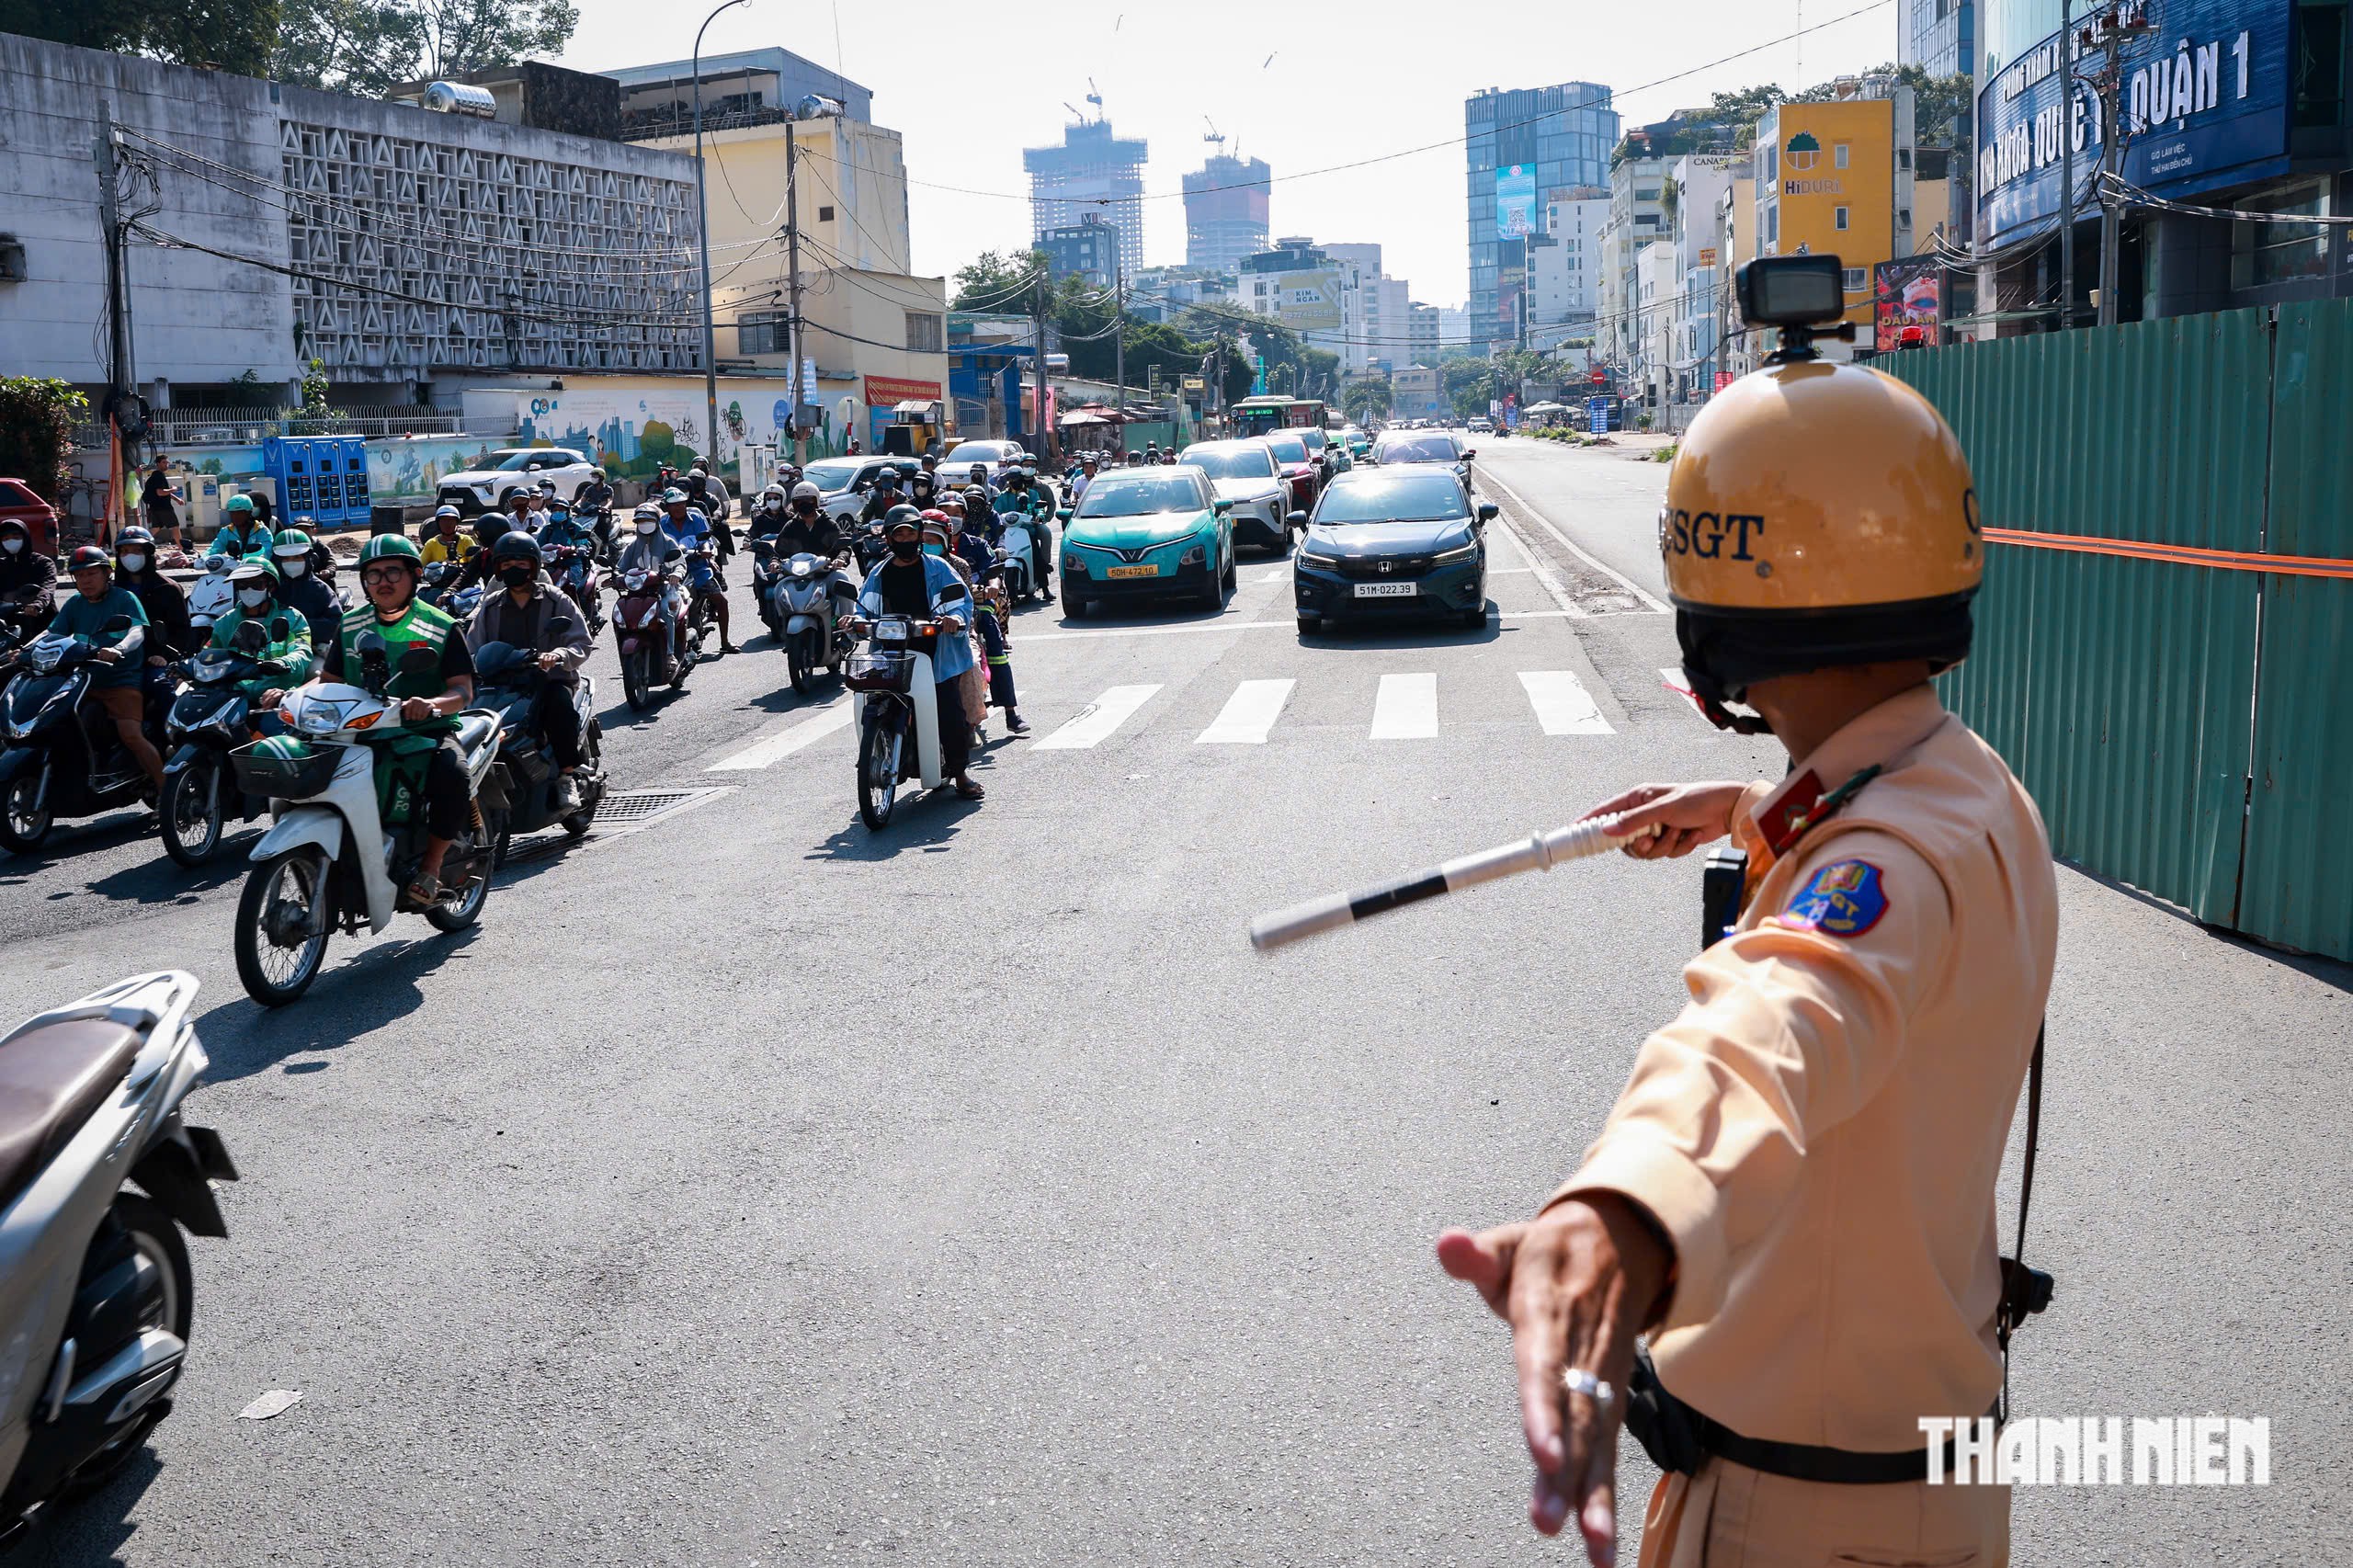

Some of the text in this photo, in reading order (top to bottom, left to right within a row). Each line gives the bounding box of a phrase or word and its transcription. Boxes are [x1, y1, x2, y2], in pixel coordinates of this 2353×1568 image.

[2131, 38, 2218, 135] QUẬN
[2232, 30, 2248, 99] 1
[1360, 585, 1411, 595] 51M-022.39
